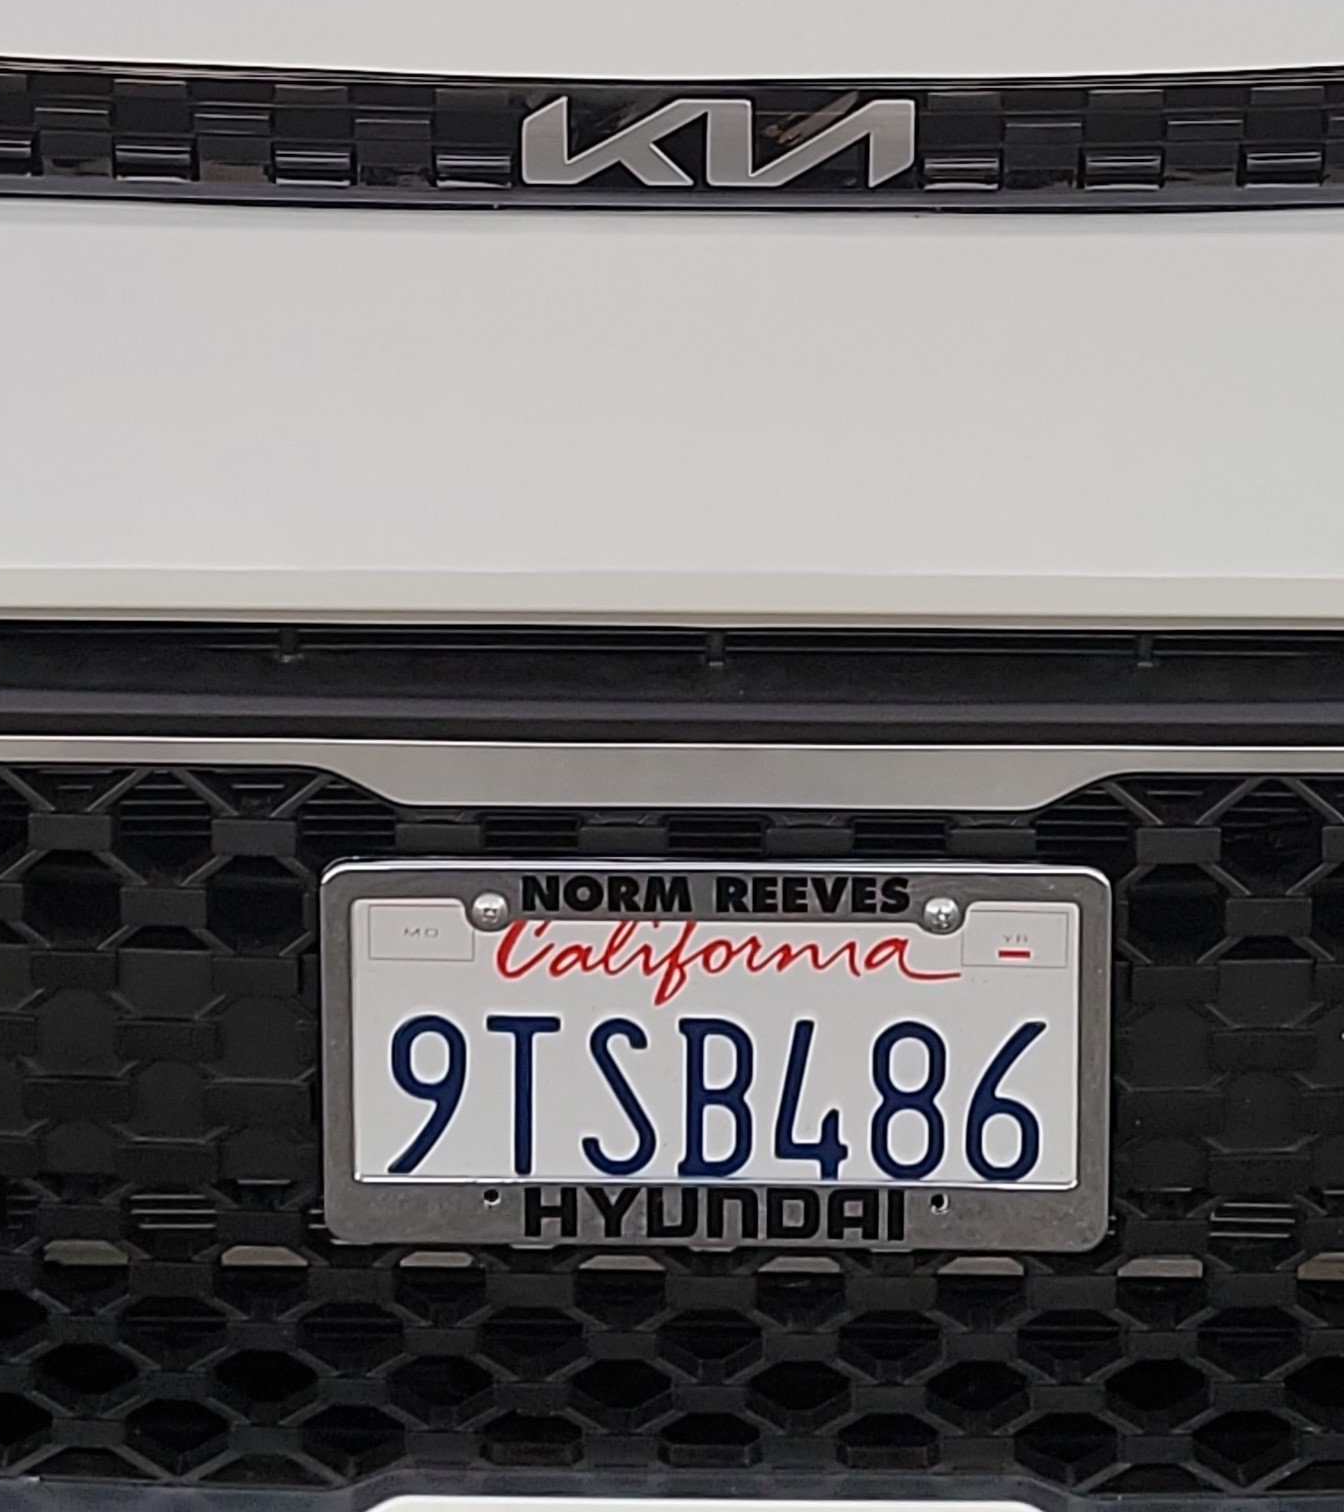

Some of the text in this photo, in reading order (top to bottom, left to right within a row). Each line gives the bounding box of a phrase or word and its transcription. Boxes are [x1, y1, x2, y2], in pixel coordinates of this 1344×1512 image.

[522, 96, 916, 188] KIA
[521, 874, 910, 915] NORM REEVES
[495, 919, 962, 1006] California
[386, 1012, 1048, 1182] 9TSB486
[523, 1186, 906, 1242] HYUNDAI
